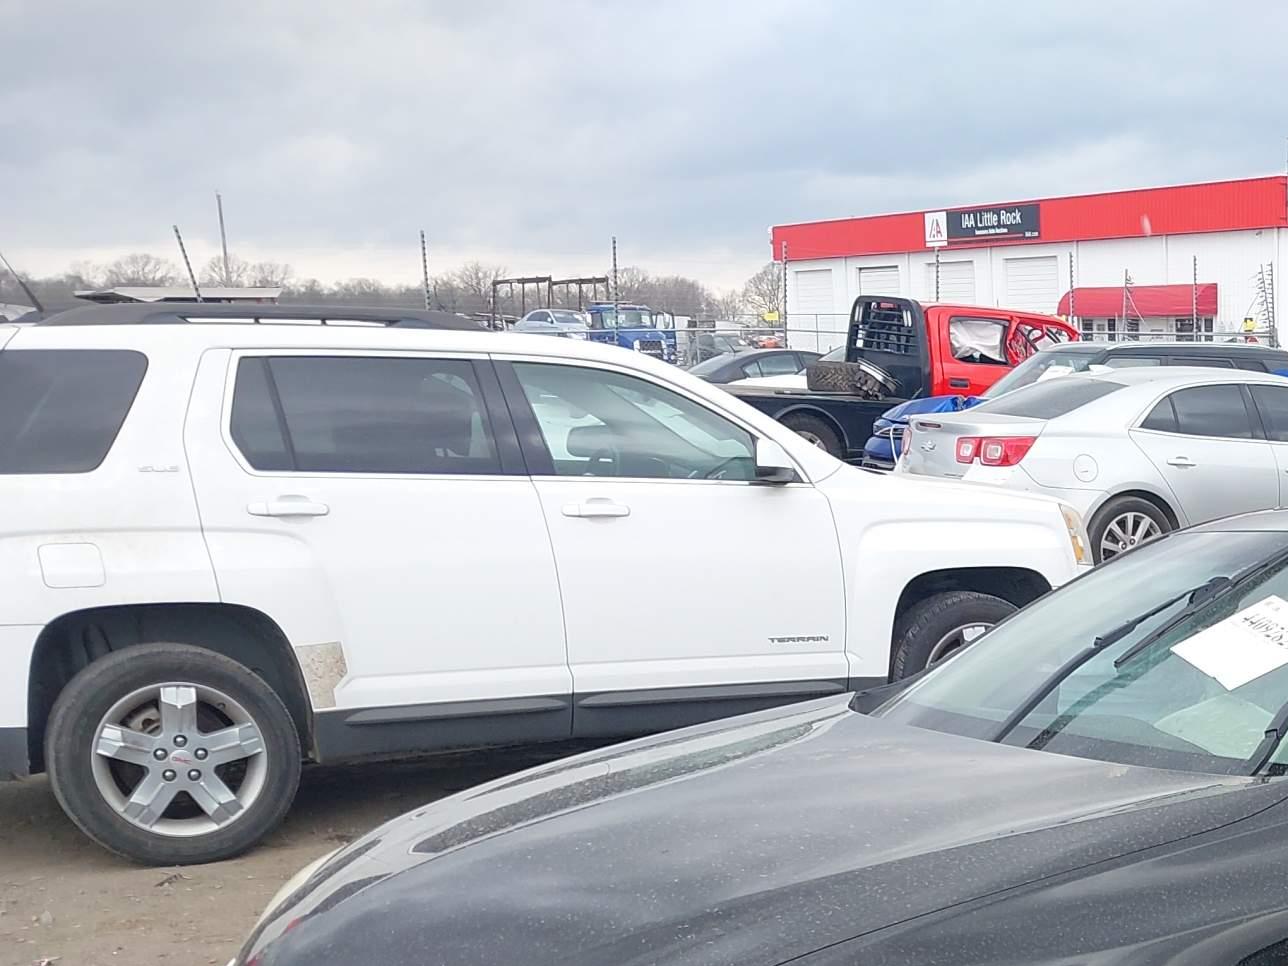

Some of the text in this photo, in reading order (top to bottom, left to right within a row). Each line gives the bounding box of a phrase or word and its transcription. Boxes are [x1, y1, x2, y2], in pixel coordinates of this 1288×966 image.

[962, 208, 1021, 228] IAA Little Rock
